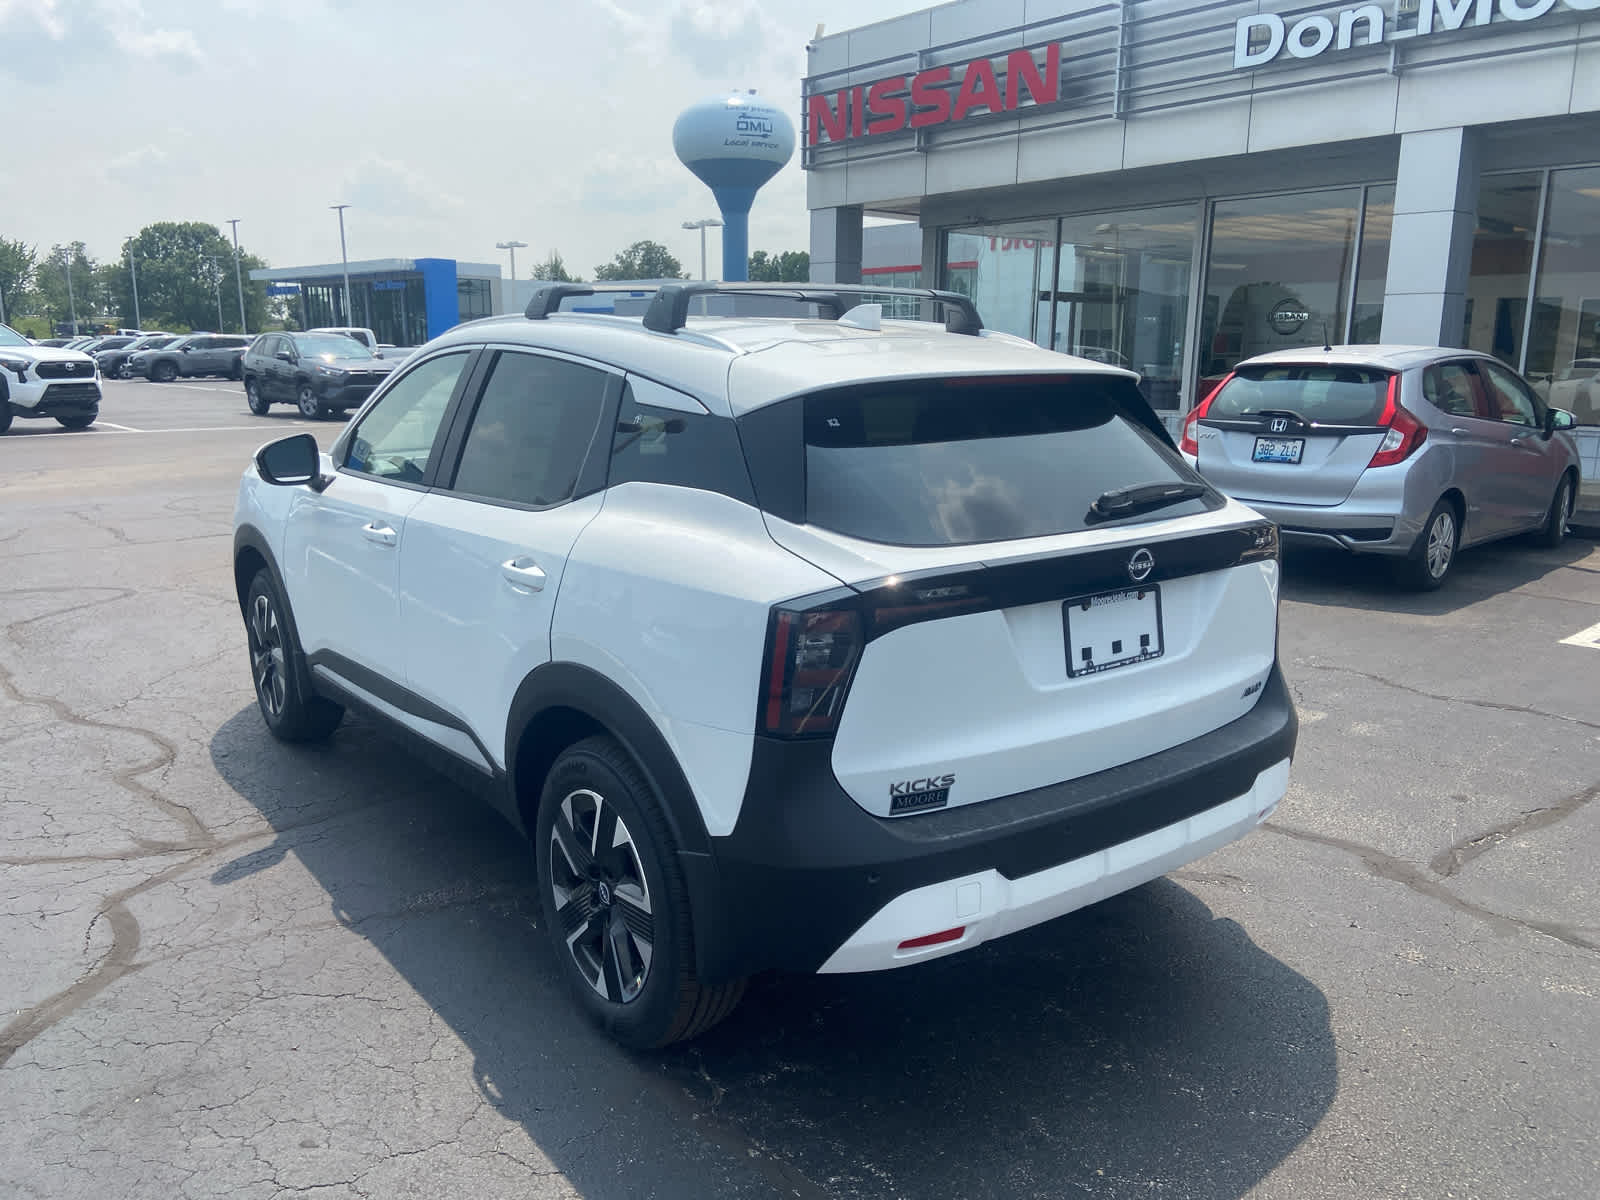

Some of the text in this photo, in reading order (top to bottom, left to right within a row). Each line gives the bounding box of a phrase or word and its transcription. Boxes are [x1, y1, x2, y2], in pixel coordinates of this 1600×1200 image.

[1233, 5, 1385, 69] Don
[808, 42, 1060, 146] NISSAN
[1258, 443, 1298, 457] 382 ZLG
[889, 773, 956, 795] KICKS
[896, 789, 944, 809] MOORE
